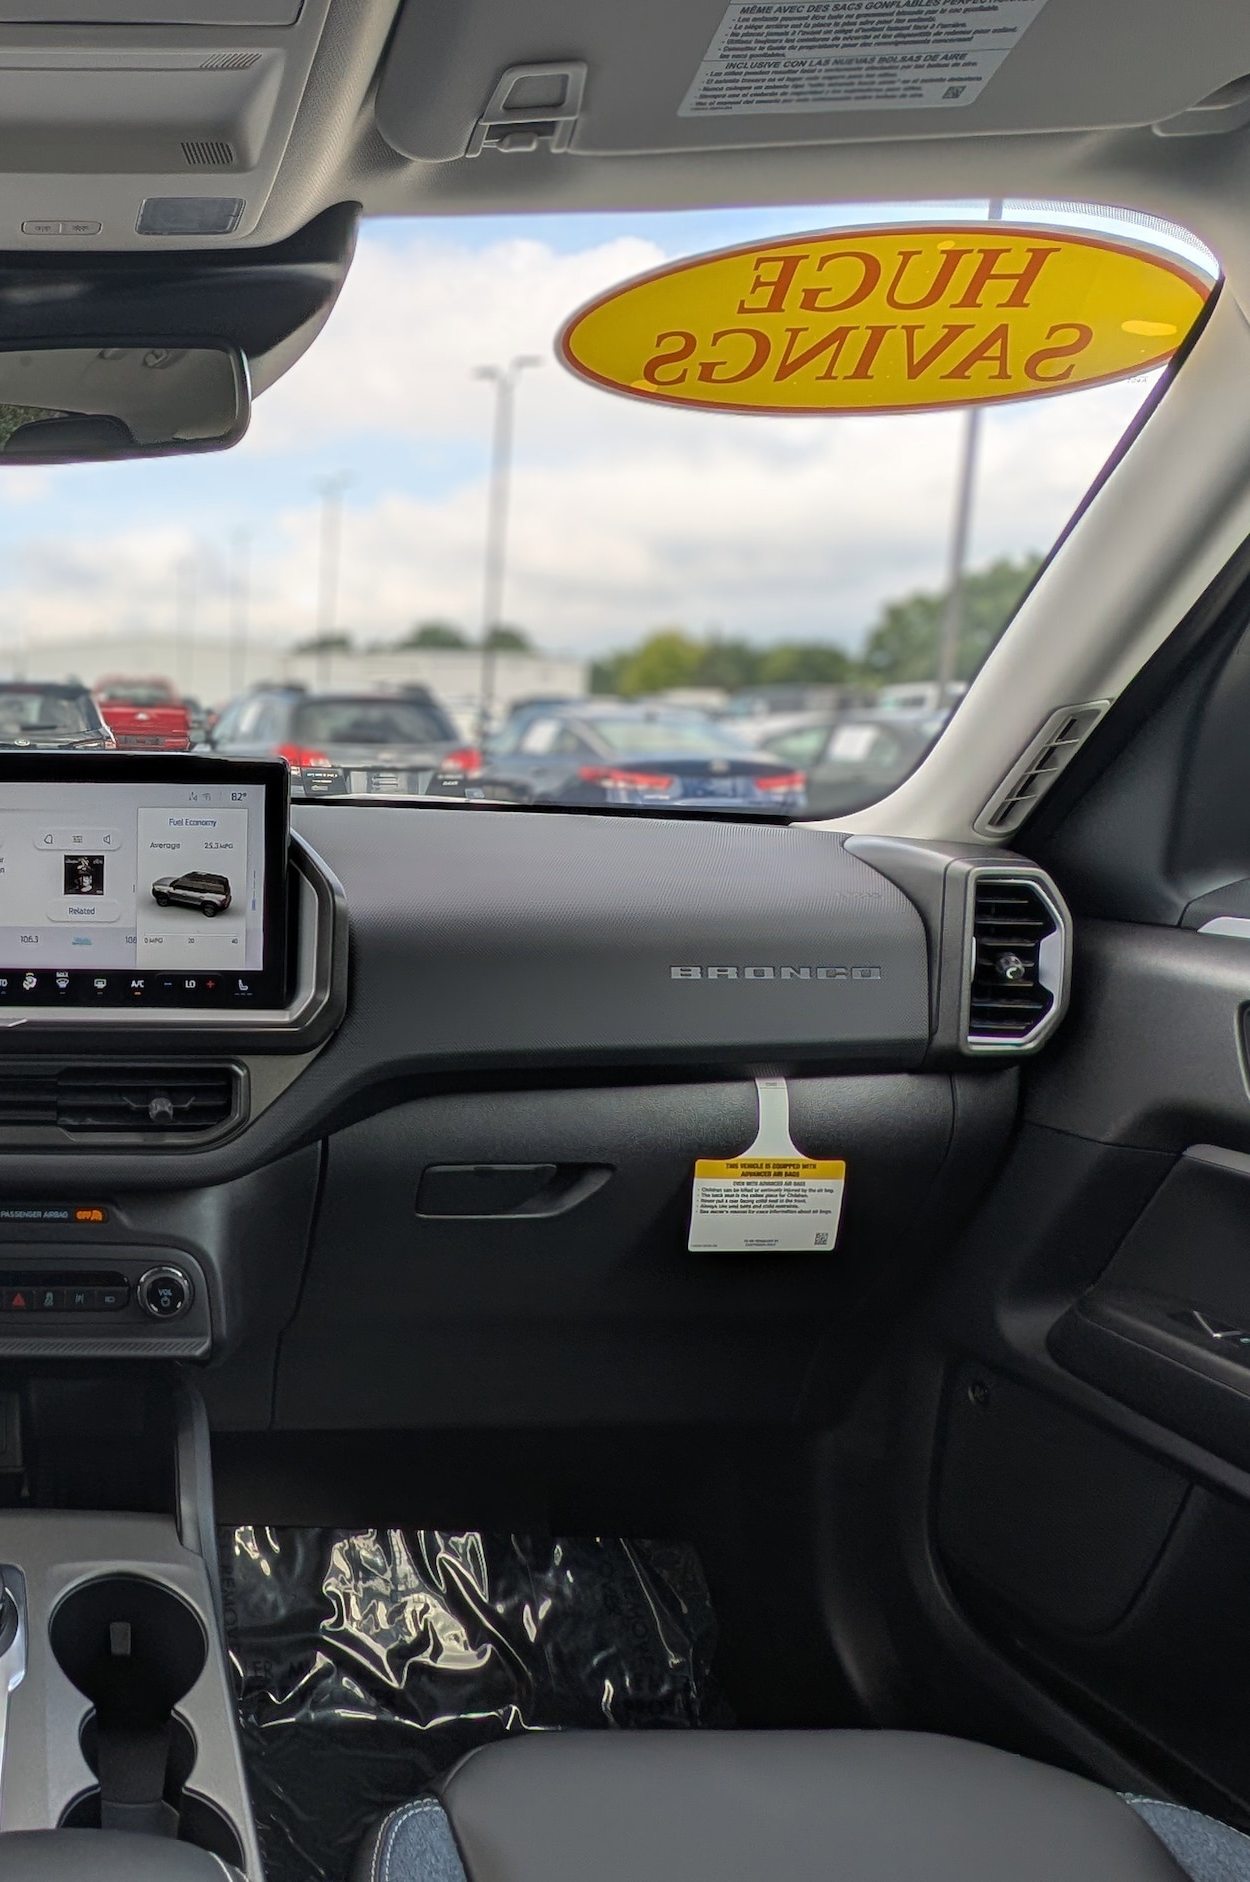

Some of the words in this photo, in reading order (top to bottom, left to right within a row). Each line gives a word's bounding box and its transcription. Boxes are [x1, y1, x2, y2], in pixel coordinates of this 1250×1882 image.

[739, 5, 773, 14] MÊME
[773, 6, 804, 14] AVEC
[806, 4, 830, 12] DES
[831, 2, 862, 11] SACS
[864, 0, 940, 10] GONFLABLES
[725, 61, 780, 69] INCLUSIVE
[783, 59, 806, 67] CON
[809, 58, 830, 66] LAS
[924, 54, 939, 62] DE
[940, 52, 968, 60] AIRE
[231, 792, 247, 801] 82°
[169, 818, 184, 826] Fuel
[185, 818, 217, 827] Economy
[150, 842, 180, 850] Average
[68, 907, 95, 916] Related
[670, 966, 882, 980] BRONCO
[131, 980, 144, 988] A/C
[185, 980, 196, 988] LO
[158, 1288, 172, 1296] VOL
